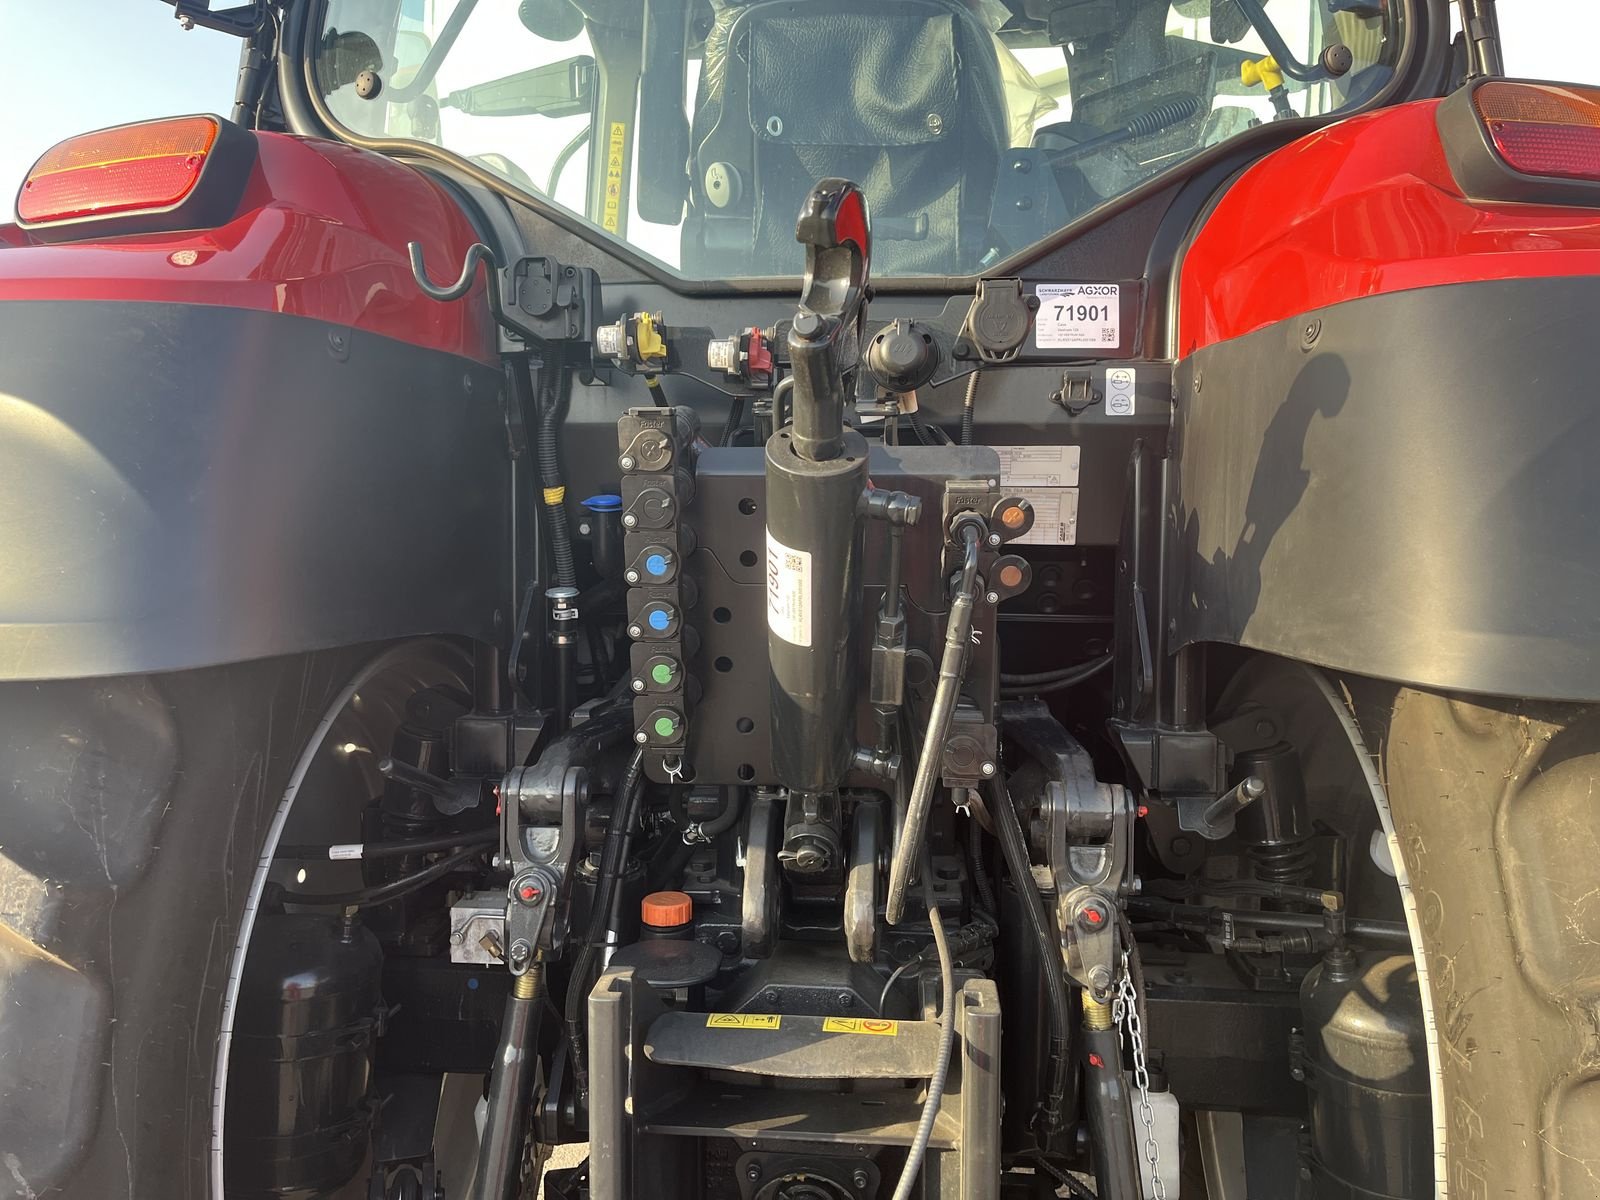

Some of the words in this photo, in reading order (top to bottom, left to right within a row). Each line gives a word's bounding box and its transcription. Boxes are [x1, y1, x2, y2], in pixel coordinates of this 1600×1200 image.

[1077, 286, 1118, 295] AGXOR
[1053, 305, 1109, 321] 71901
[767, 546, 780, 616] 71901
